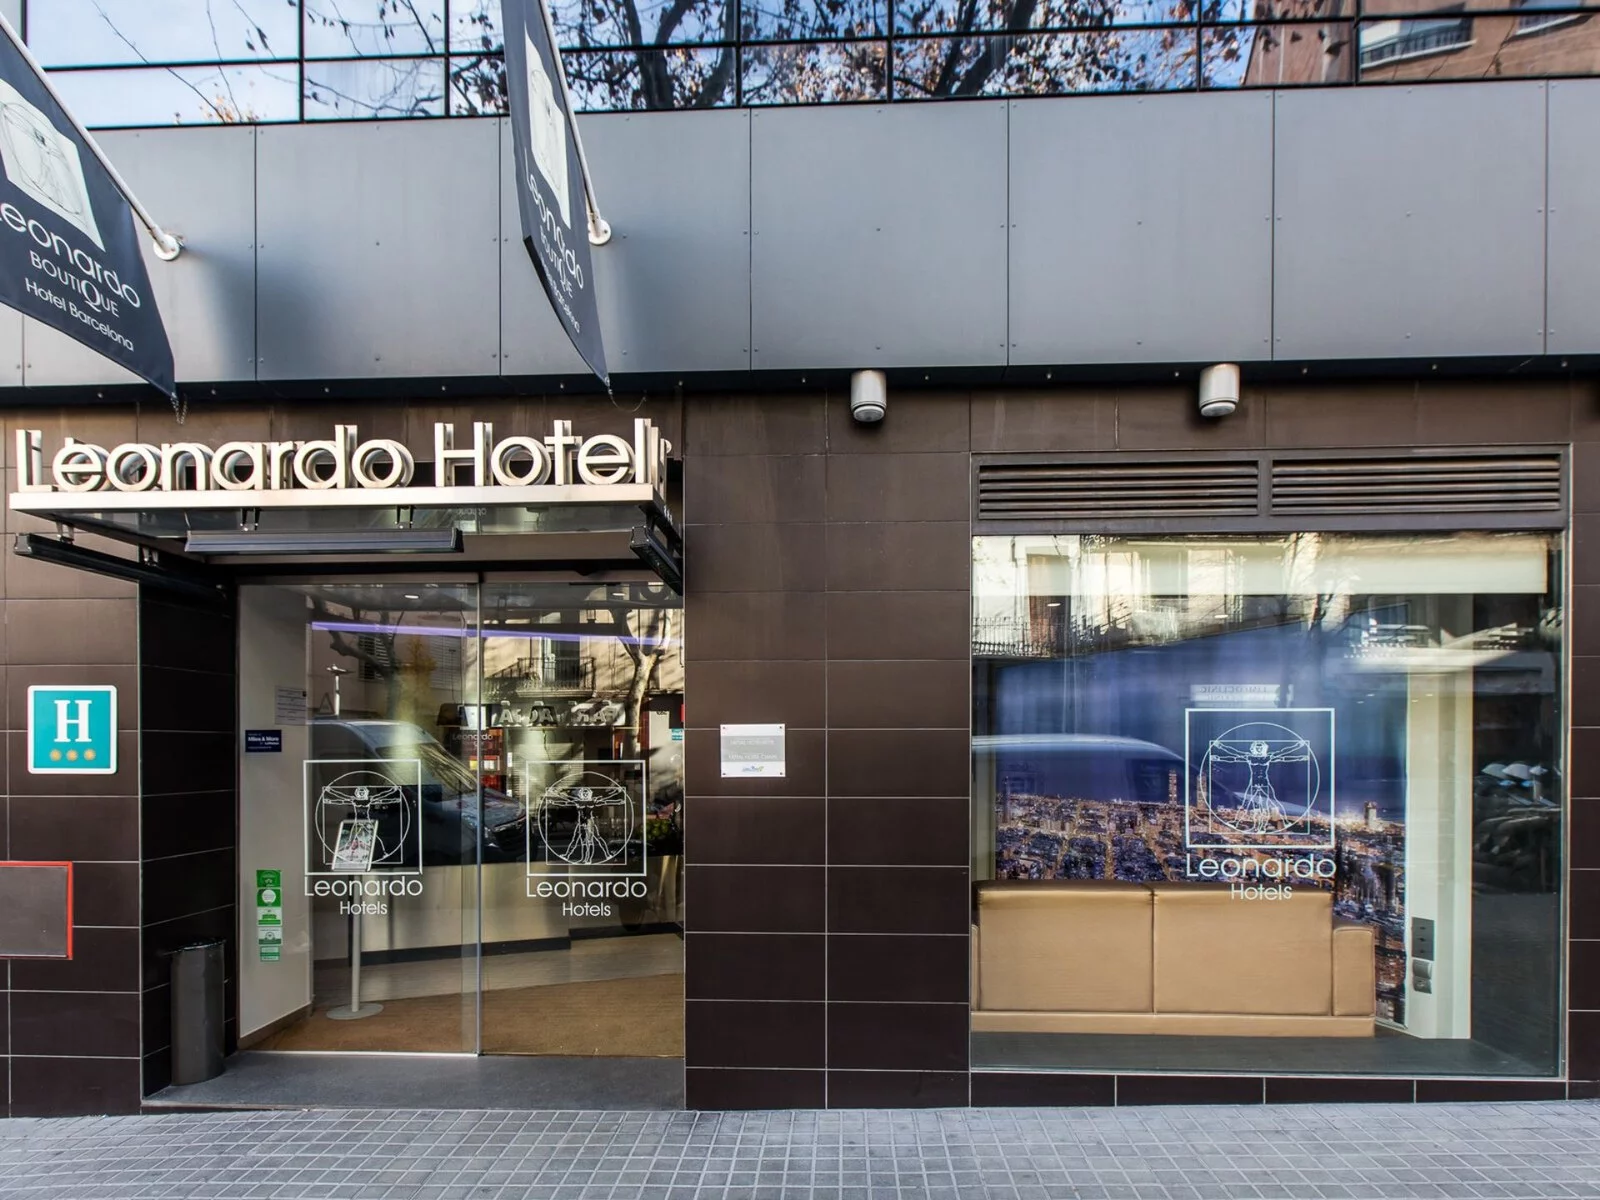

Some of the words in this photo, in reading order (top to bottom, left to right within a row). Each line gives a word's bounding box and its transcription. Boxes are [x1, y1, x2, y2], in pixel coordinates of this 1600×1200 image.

[0, 203, 141, 309] eonardo
[30, 250, 120, 318] BOUTIQUE
[25, 277, 67, 311] Hotel
[69, 301, 134, 352] Barcelona
[16, 424, 413, 492] Leonardo
[434, 417, 652, 487] Hotel
[53, 699, 93, 743] H
[1186, 853, 1337, 878] Leonardo
[304, 875, 423, 897] Leonardo
[526, 877, 648, 898] Leonardo
[1230, 883, 1293, 901] Hotels
[340, 900, 388, 915] Hotels
[562, 902, 612, 917] Hotels
